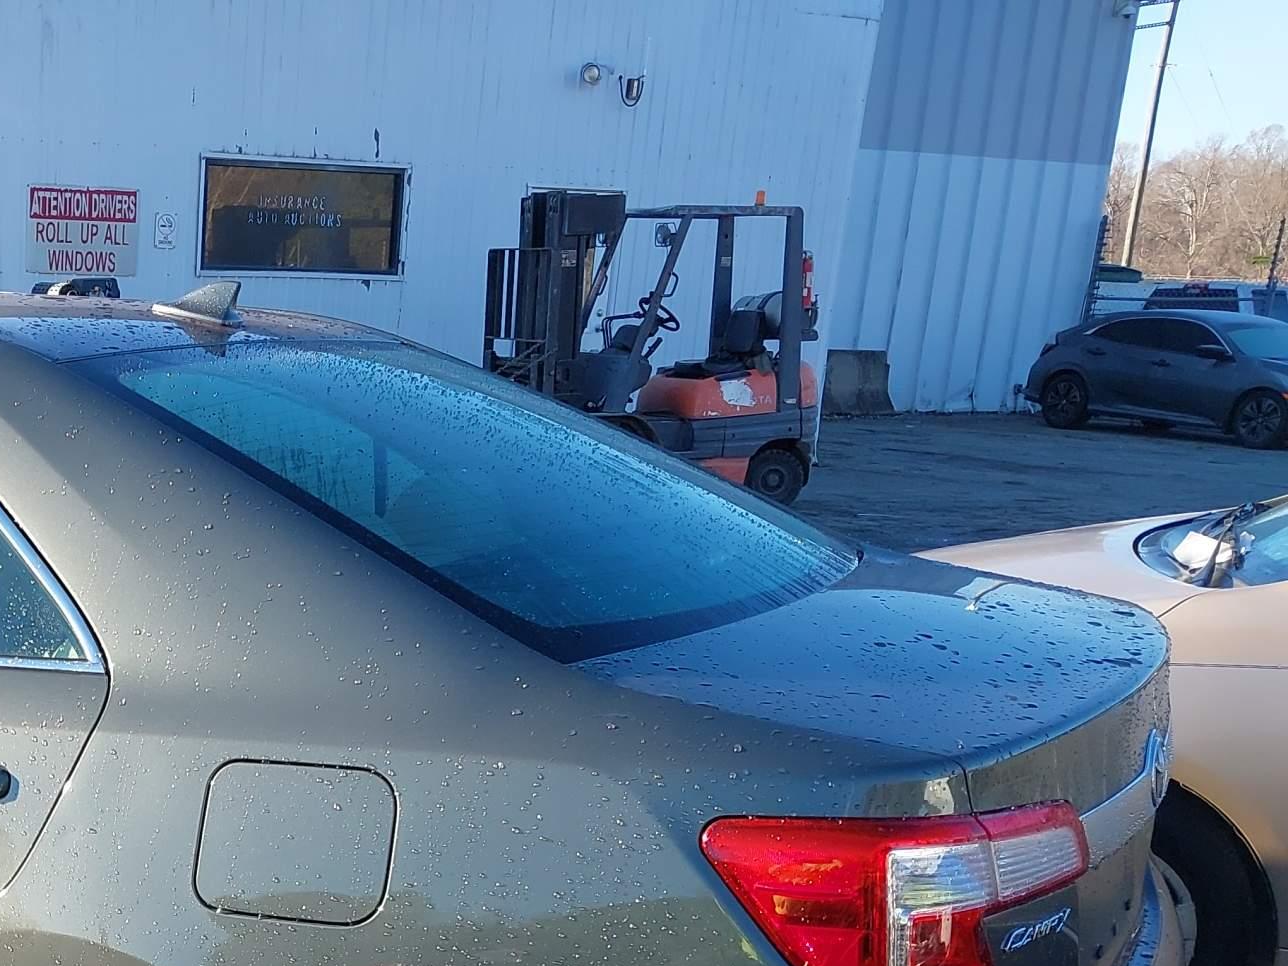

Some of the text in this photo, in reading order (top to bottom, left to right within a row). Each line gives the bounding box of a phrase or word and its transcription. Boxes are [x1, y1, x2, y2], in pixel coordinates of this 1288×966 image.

[30, 190, 137, 220] ATTENTION DRIVERS
[257, 194, 328, 211] INSURANCE
[247, 211, 343, 228] AUTO AUCTIONS
[35, 222, 129, 246] ROLL UP ALL
[47, 249, 116, 273] WINDOWS
